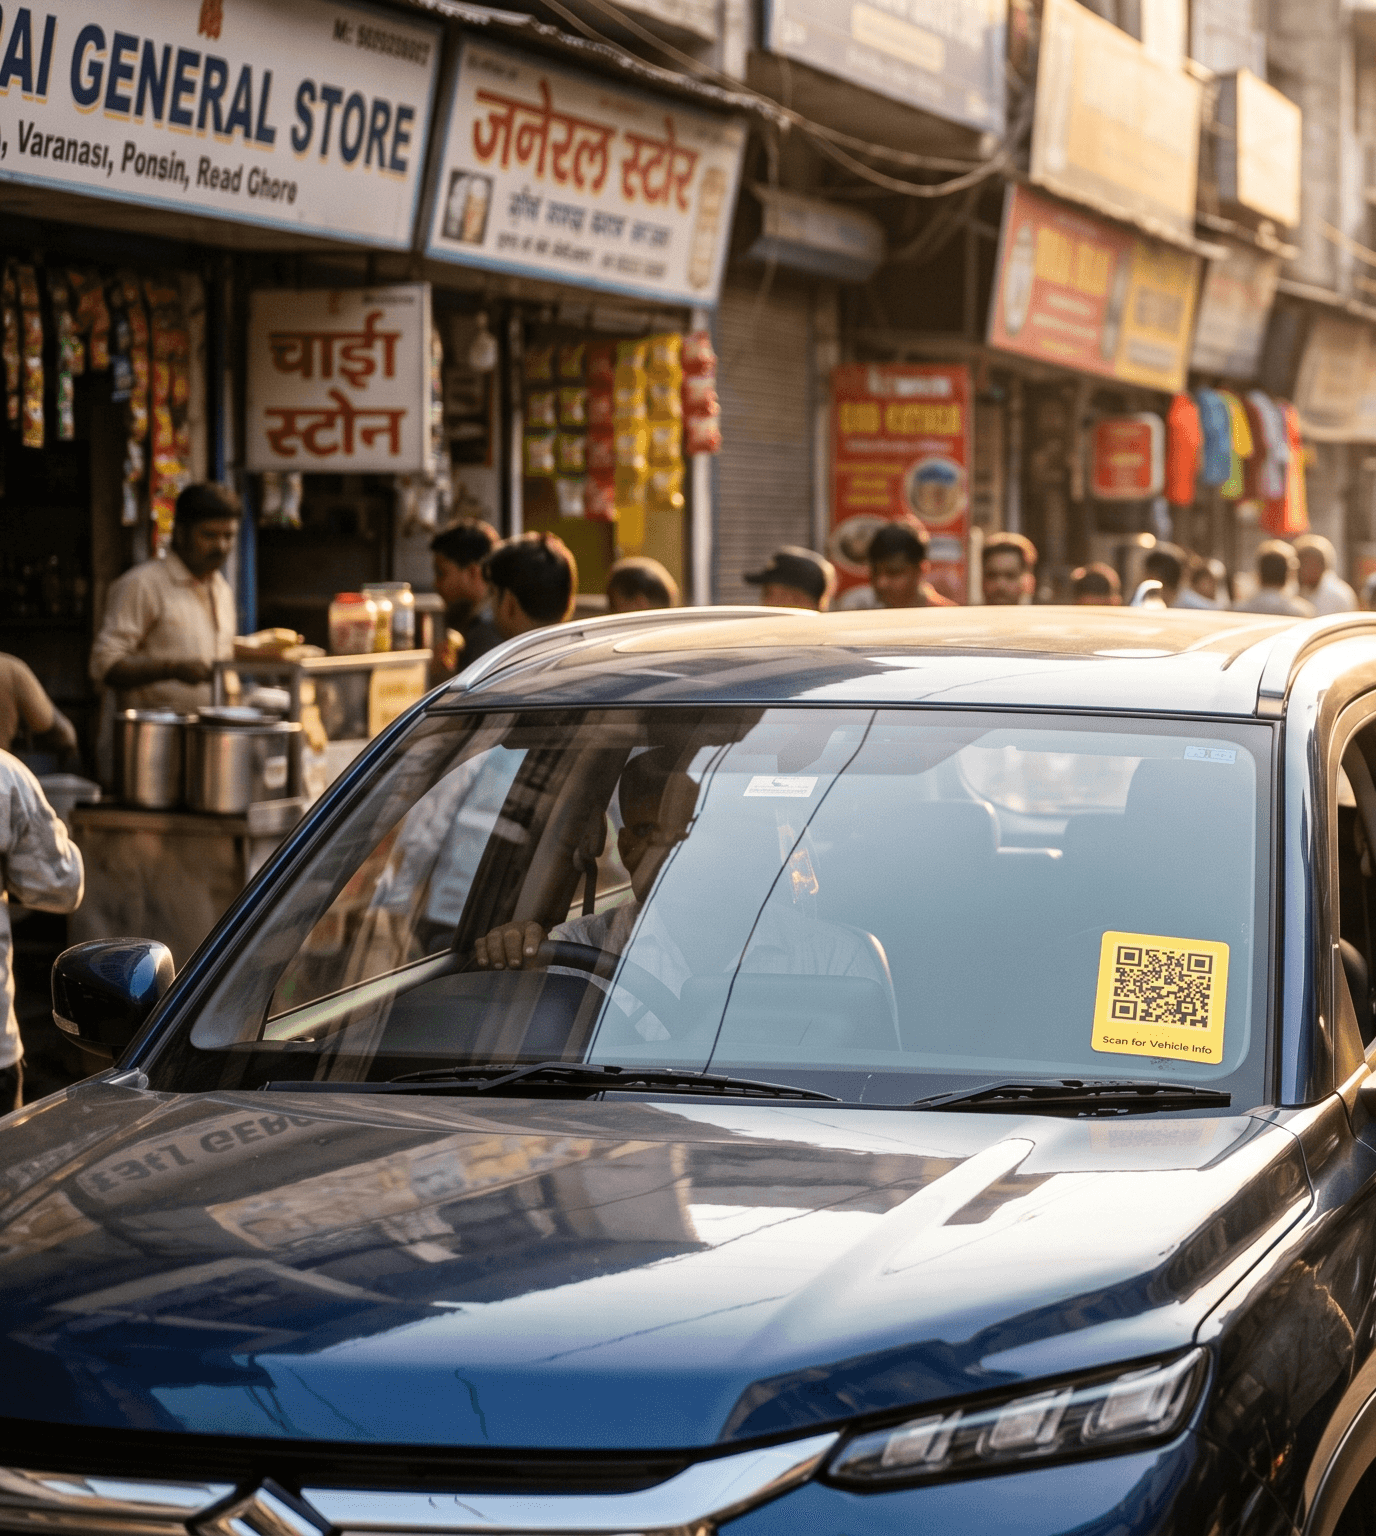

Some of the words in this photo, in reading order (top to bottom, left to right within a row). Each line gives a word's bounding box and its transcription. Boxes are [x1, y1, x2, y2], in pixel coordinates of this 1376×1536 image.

[0, 4, 57, 97] AI
[70, 22, 278, 146] GENERAL
[290, 77, 416, 174] STORE
[196, 154, 244, 195] Read
[264, 387, 407, 458] स्टोन
[1102, 1035, 1128, 1045] Scan
[1131, 1038, 1146, 1046] for
[1150, 1040, 1189, 1051] Vehicle
[1192, 1044, 1212, 1054] Info
